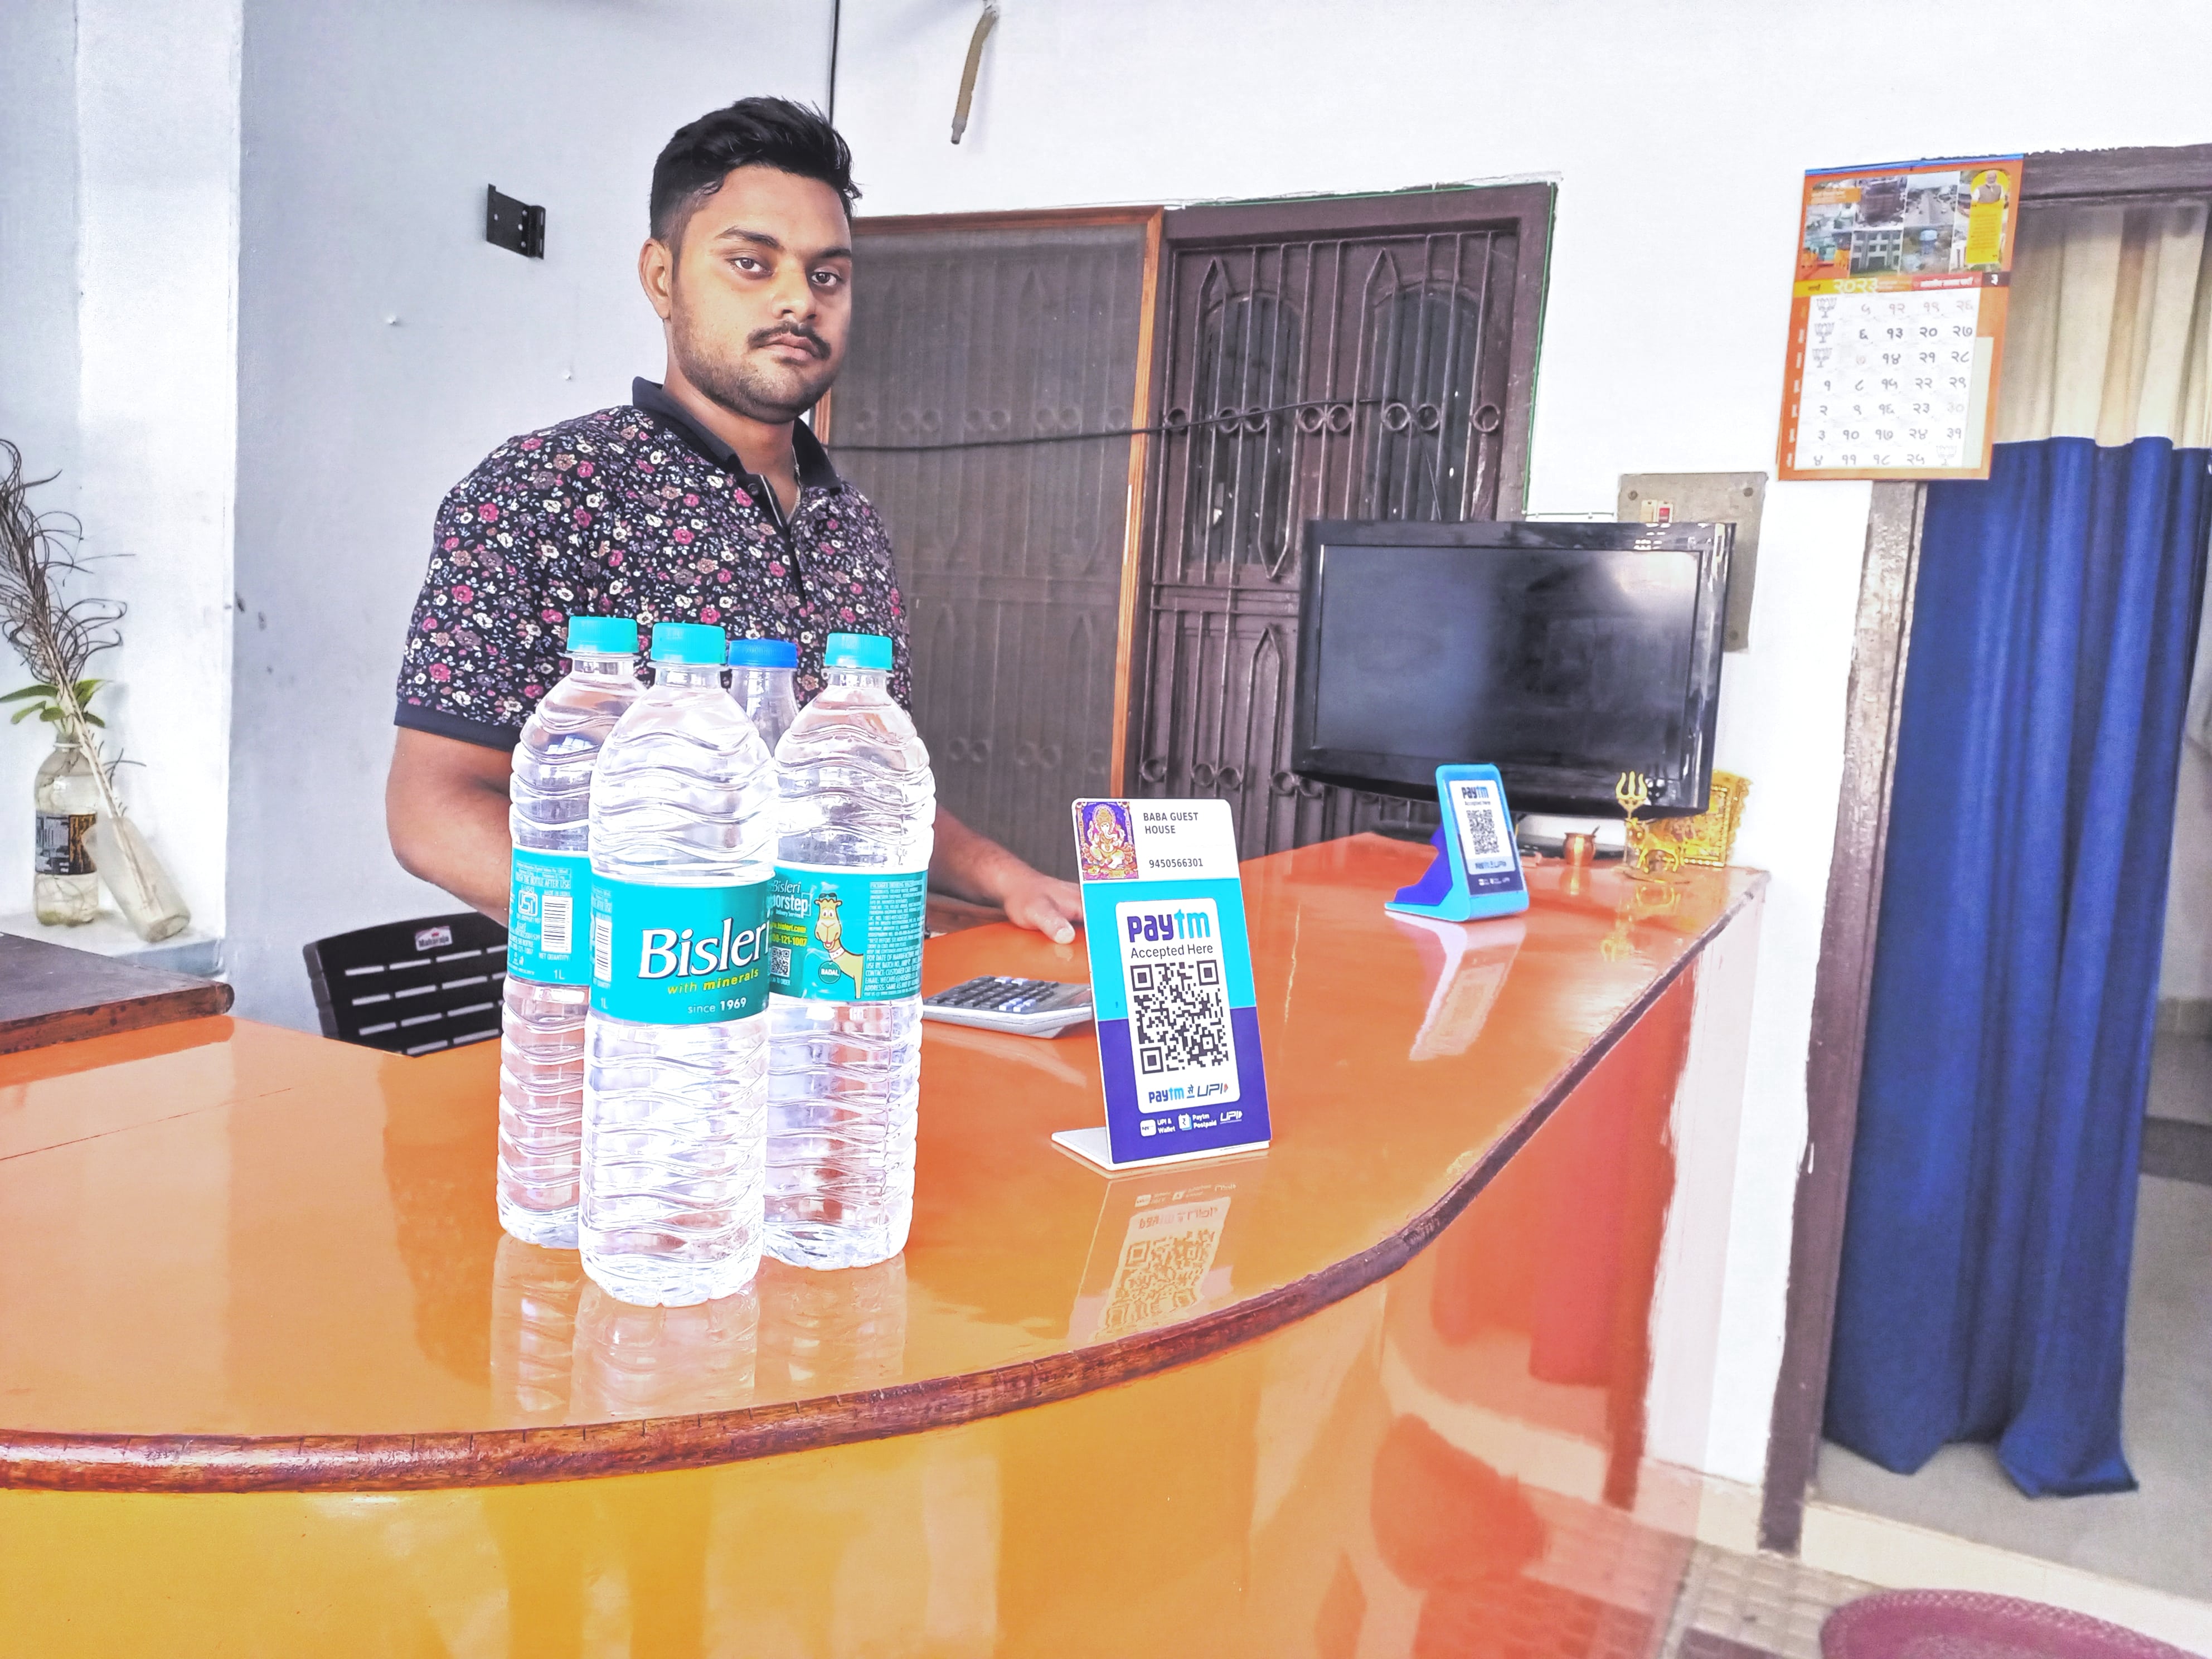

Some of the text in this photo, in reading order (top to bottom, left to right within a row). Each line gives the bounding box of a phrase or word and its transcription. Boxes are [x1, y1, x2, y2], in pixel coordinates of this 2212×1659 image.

[1889, 303, 1905, 314] १२
[1886, 328, 1903, 339] १३
[1919, 327, 1938, 337] २०
[1953, 326, 1973, 337] २७
[1883, 353, 1901, 365] १४
[1919, 352, 1936, 363] २१
[1951, 351, 1970, 363] २८
[1823, 380, 1831, 391] १
[1915, 377, 1933, 388] २२
[1820, 405, 1828, 415] २
[1913, 403, 1930, 414] २३
[1818, 430, 1825, 440] ३
[1842, 429, 1860, 440] १०
[1909, 428, 1928, 439] २४
[1947, 428, 1962, 439] ३१
[1143, 812, 1199, 821] BABA GUEST
[1145, 825, 1176, 834] HOUSE
[1149, 858, 1204, 868] 9450566301
[637, 909, 770, 979] Bisleri
[1131, 944, 1213, 959] Accepted Here
[821, 968, 840, 976] BADAL
[667, 968, 759, 995] with minerals
[688, 997, 746, 1013] since 1969
[1197, 1083, 1224, 1097] UPI
